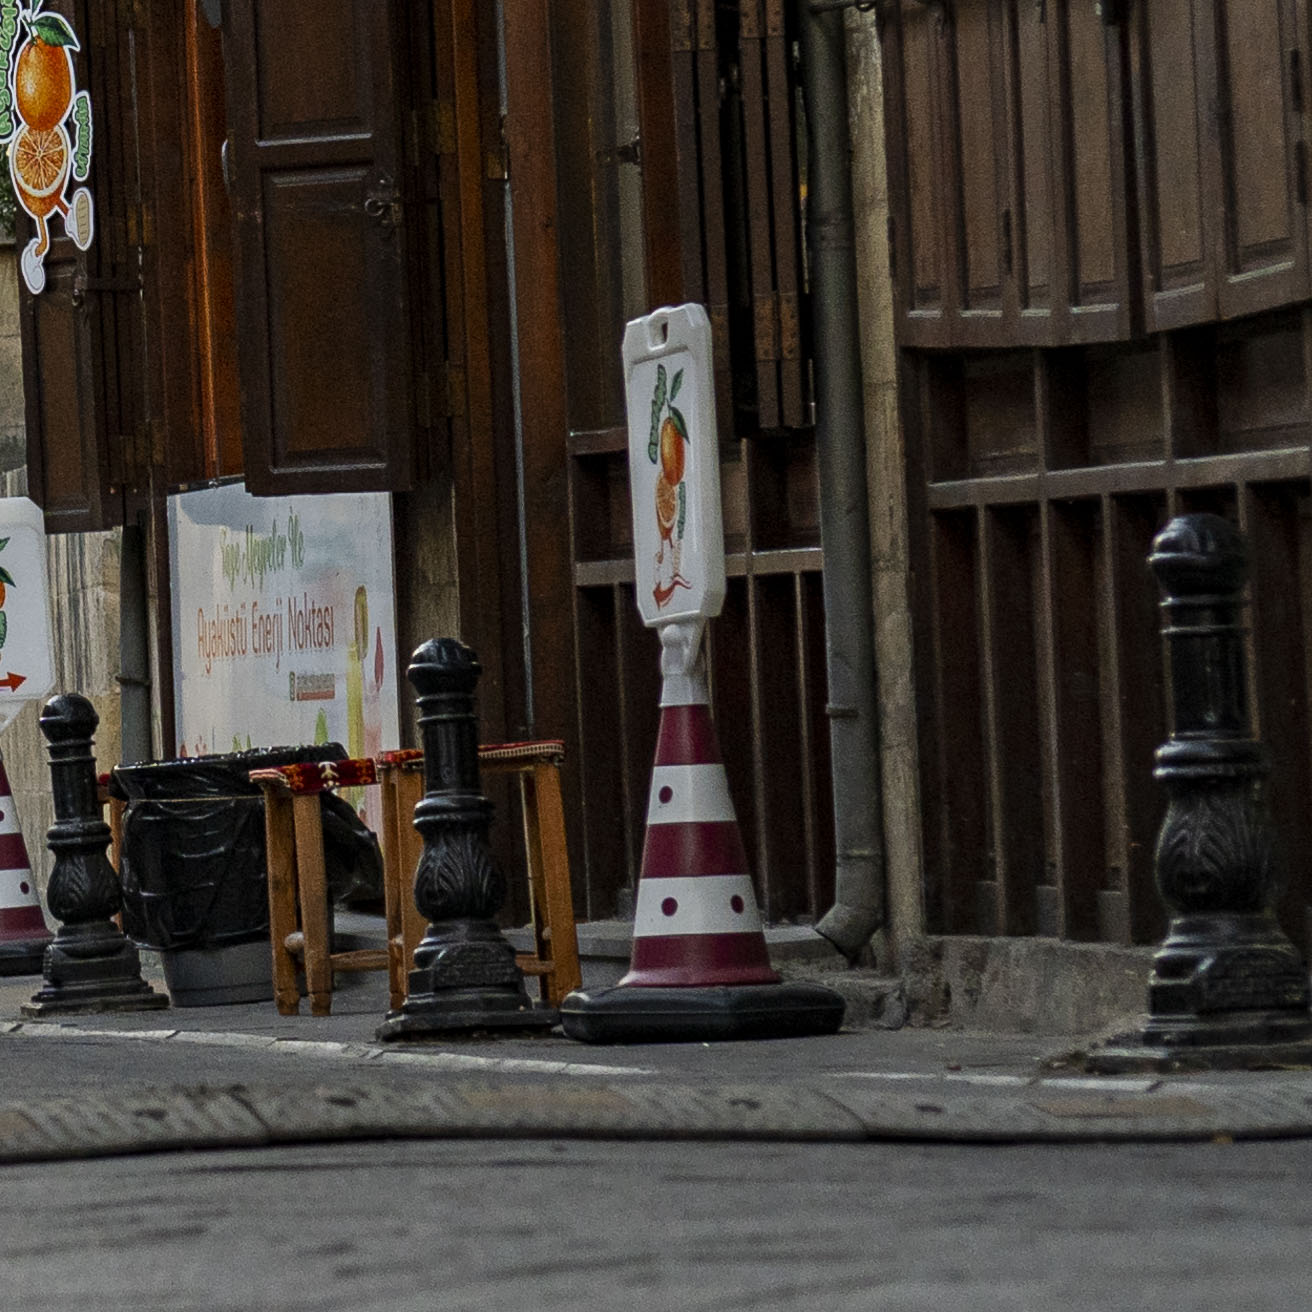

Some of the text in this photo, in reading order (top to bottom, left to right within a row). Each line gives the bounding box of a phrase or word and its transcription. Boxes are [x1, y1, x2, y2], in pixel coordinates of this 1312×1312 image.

[197, 592, 335, 675] Ayaküstü Enerji Noktası
